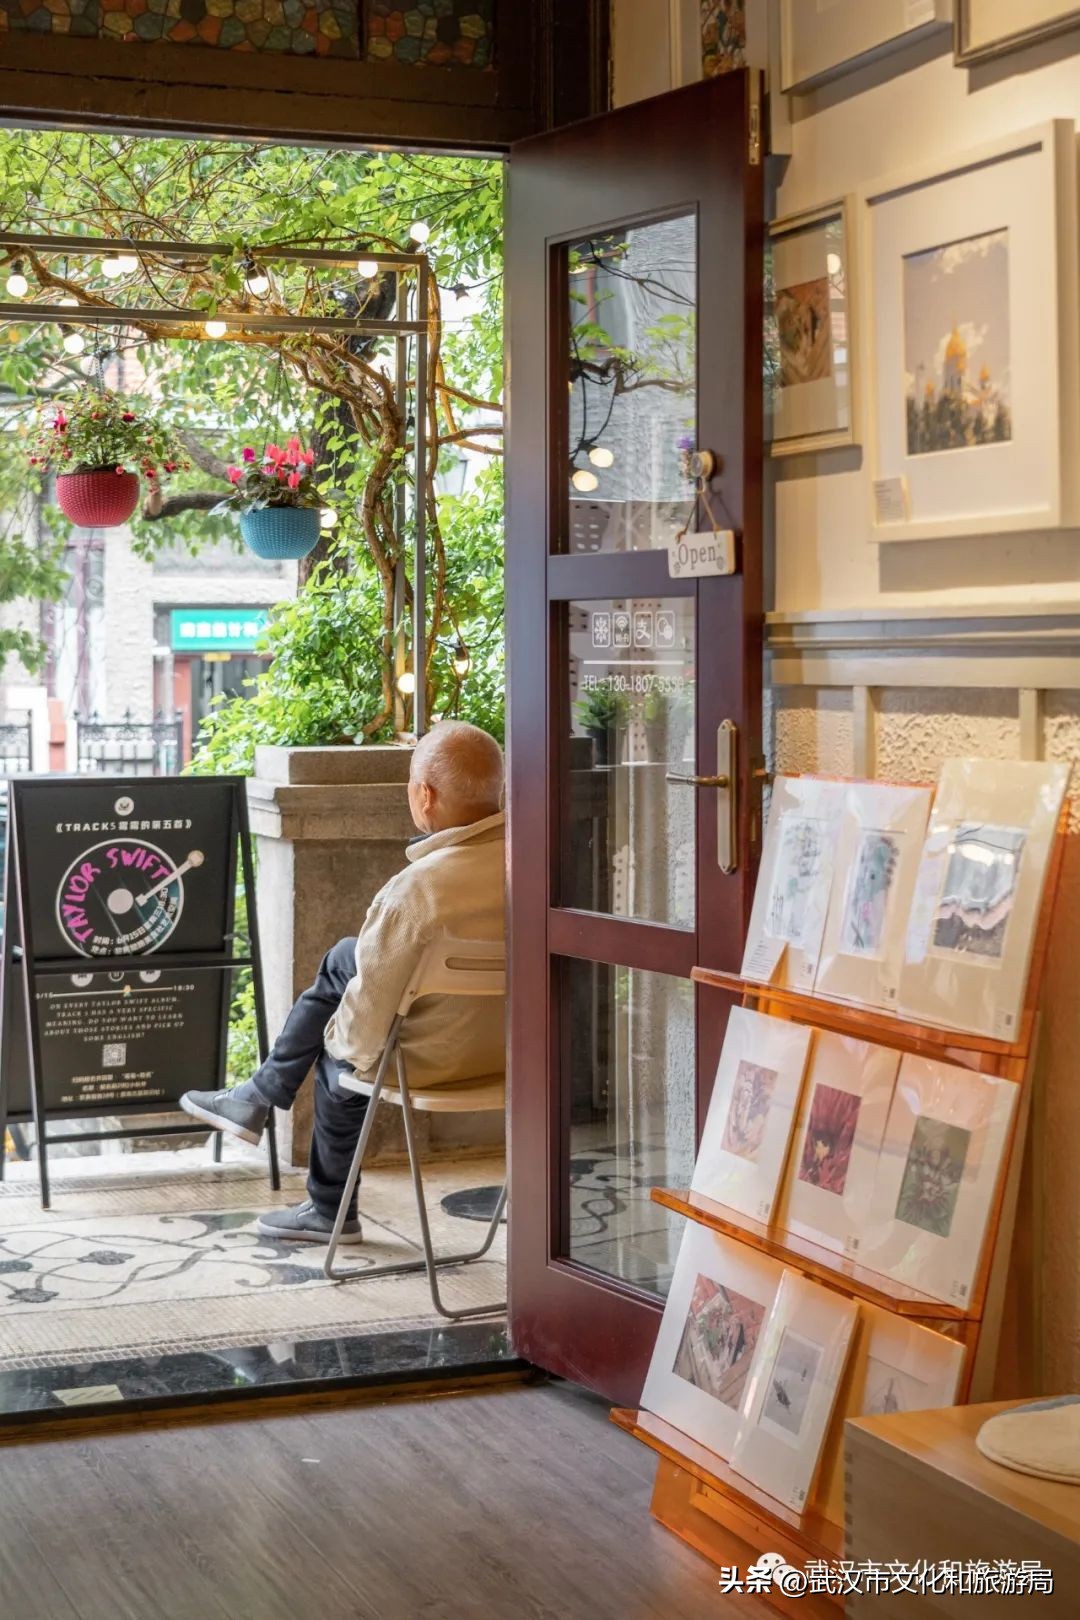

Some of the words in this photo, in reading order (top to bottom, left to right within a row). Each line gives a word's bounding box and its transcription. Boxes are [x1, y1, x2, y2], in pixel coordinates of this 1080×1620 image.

[679, 544, 716, 570] Open
[62, 863, 101, 943] TAYLOR
[106, 848, 172, 879] SWIFT
